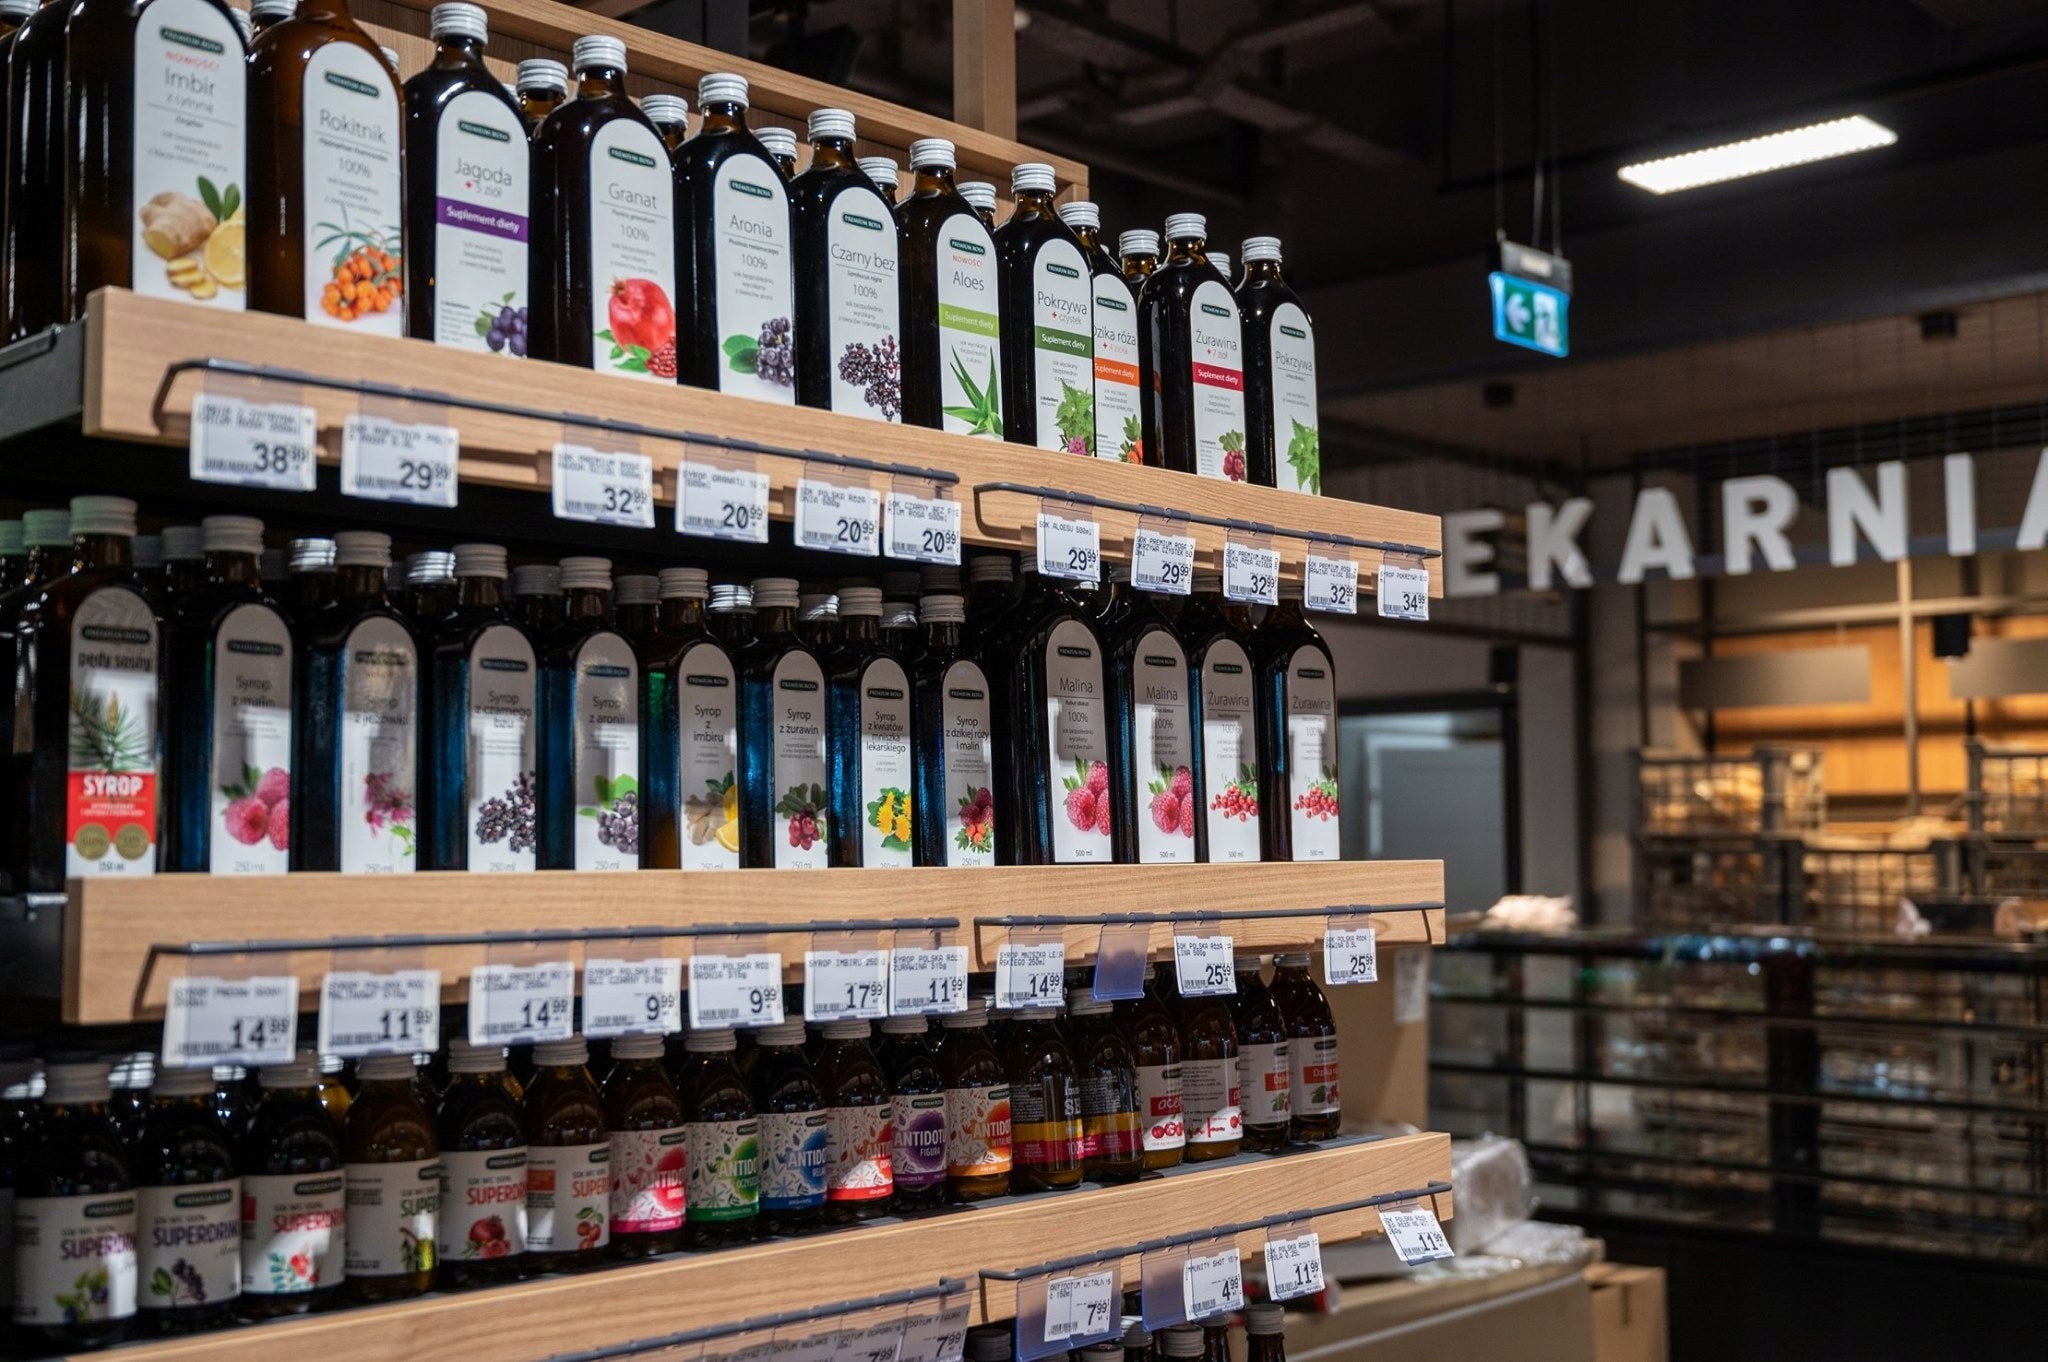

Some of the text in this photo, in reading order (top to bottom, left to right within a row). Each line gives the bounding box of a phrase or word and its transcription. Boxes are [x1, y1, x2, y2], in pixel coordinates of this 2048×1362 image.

[164, 66, 216, 97] Imbir
[320, 108, 386, 144] Rokitnik
[338, 156, 371, 179] 100%
[454, 157, 512, 187] Jagoda
[609, 183, 658, 210] Granat
[446, 204, 520, 234] Suplement diety
[729, 215, 773, 238] Aronia
[621, 224, 650, 242] 100%
[741, 254, 768, 270] 100%
[831, 244, 895, 272] Czarny bez
[852, 283, 878, 299] 100%
[953, 270, 984, 291] Aloes
[1037, 290, 1087, 315] Pokrzywa
[944, 310, 993, 331] Suplement diety
[1059, 313, 1081, 325] czystek
[1041, 333, 1085, 351] Suplement diety
[1117, 327, 1136, 346] róża
[1196, 331, 1237, 351] Żurawina
[1275, 350, 1312, 372] Pokrzywa
[1118, 367, 1135, 380] diety
[1198, 368, 1238, 385] Suplement diety
[254, 443, 288, 473] 38
[400, 460, 432, 490] 29
[604, 487, 632, 514] 32
[722, 503, 748, 529] 20
[837, 519, 861, 543] 20
[923, 530, 944, 553] 20
[1069, 549, 1087, 570] 29
[1162, 563, 1180, 584] 29
[1251, 575, 1267, 596] 32
[1331, 585, 1345, 605] 32
[1403, 593, 1417, 612] 34
[1060, 678, 1093, 694] Malina
[1147, 685, 1178, 701] Malina
[488, 690, 519, 706] Syrop
[593, 696, 620, 711] Syrop
[695, 704, 722, 718] Syrop
[787, 709, 811, 721] Syrop
[875, 711, 896, 723] Syrop
[956, 716, 978, 727] Syrop
[1068, 711, 1088, 723] 100%
[693, 731, 724, 743] imbiru
[786, 723, 819, 735] żurawin
[871, 732, 900, 742] mniszka
[873, 721, 903, 732] kwiatów
[951, 728, 973, 739] dzikiej
[866, 742, 906, 754] lekarskiego
[960, 742, 979, 751] malin
[83, 775, 143, 795] SYROP
[1205, 965, 1223, 986] 25
[1351, 956, 1366, 975] 25
[846, 985, 870, 1008] 17
[930, 981, 949, 1003] 11
[1030, 975, 1049, 997] 14
[646, 996, 660, 1020] 9
[750, 989, 763, 1014] 9
[380, 1010, 410, 1039] 11
[523, 1001, 550, 1029] 14
[231, 1019, 265, 1049] 14
[920, 1146, 941, 1157] FIGURA
[1418, 1232, 1439, 1251] 11
[1295, 1265, 1310, 1286] 11
[1221, 1281, 1231, 1301] 4
[1087, 1304, 1097, 1327] 7
[936, 1336, 949, 1357] 7
